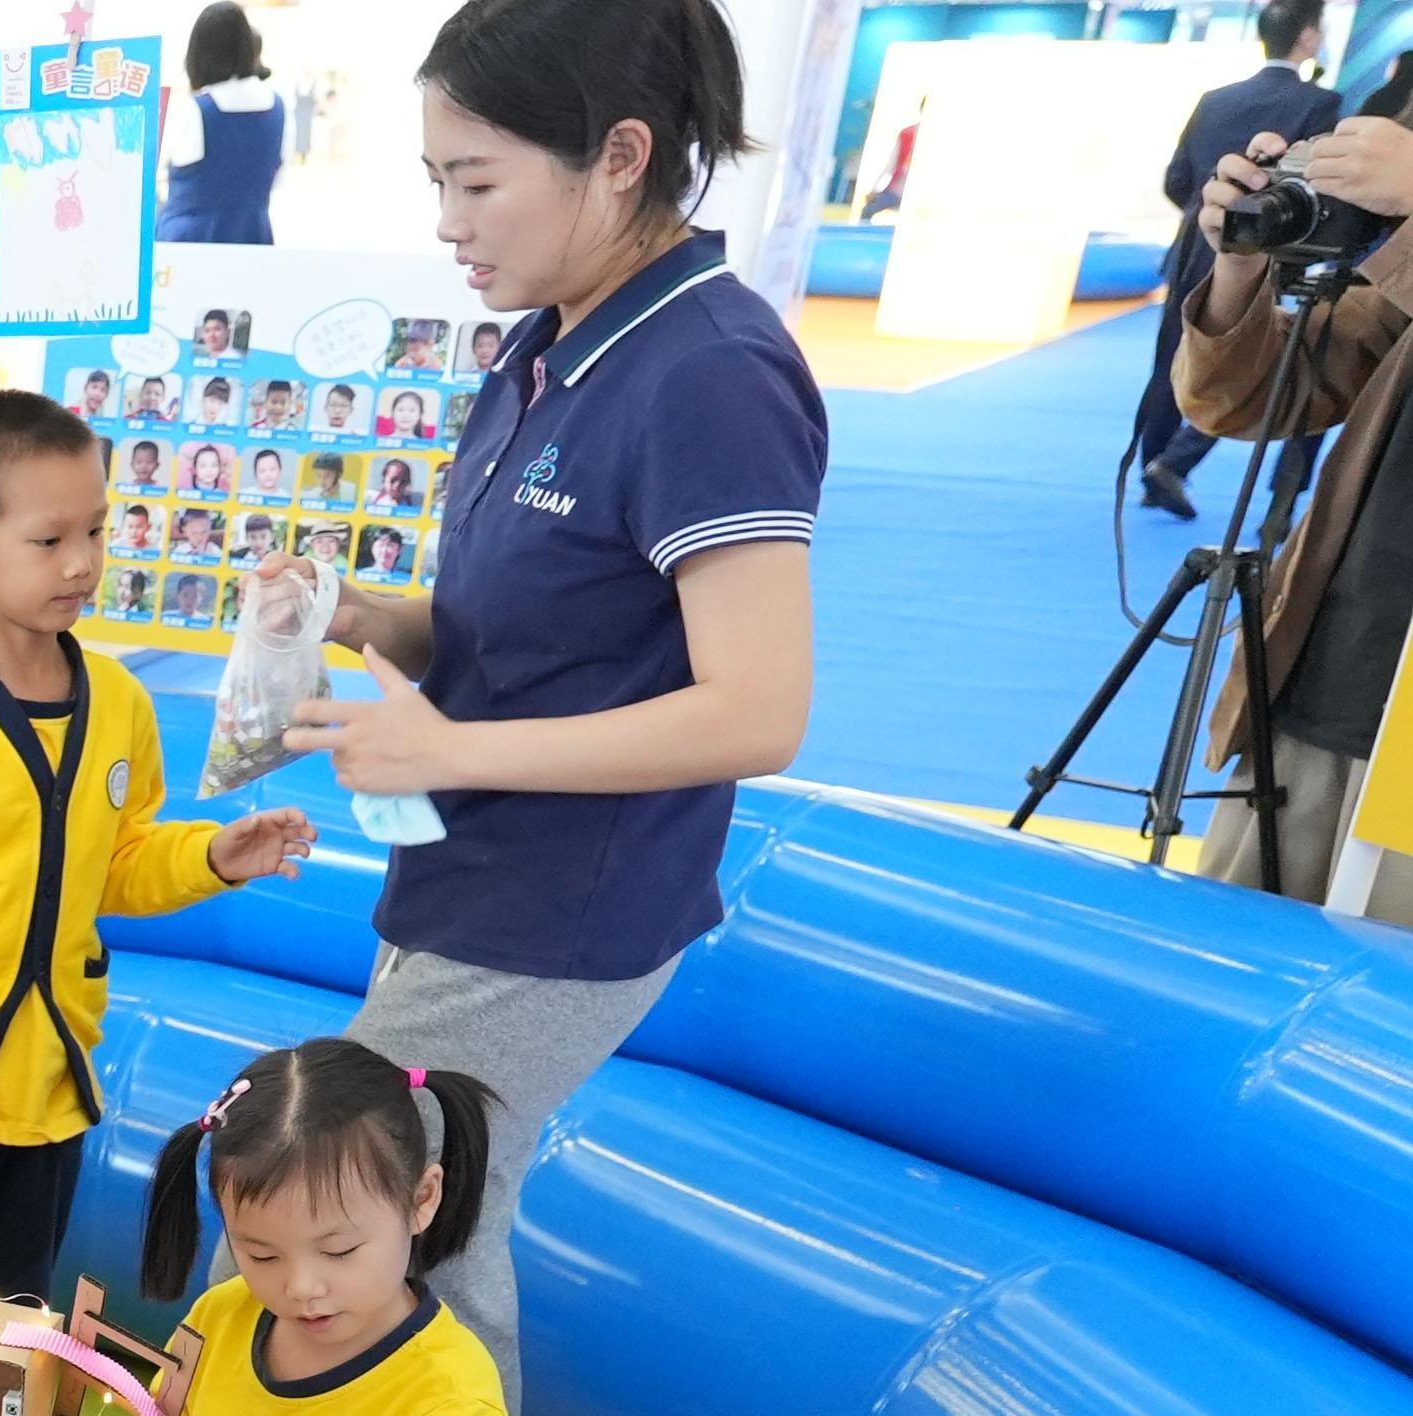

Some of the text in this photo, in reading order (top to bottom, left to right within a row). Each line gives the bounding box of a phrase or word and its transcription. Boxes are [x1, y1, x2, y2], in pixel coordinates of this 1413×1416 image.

[44, 49, 149, 97] 童言童语
[514, 484, 578, 516] LIYUAN
